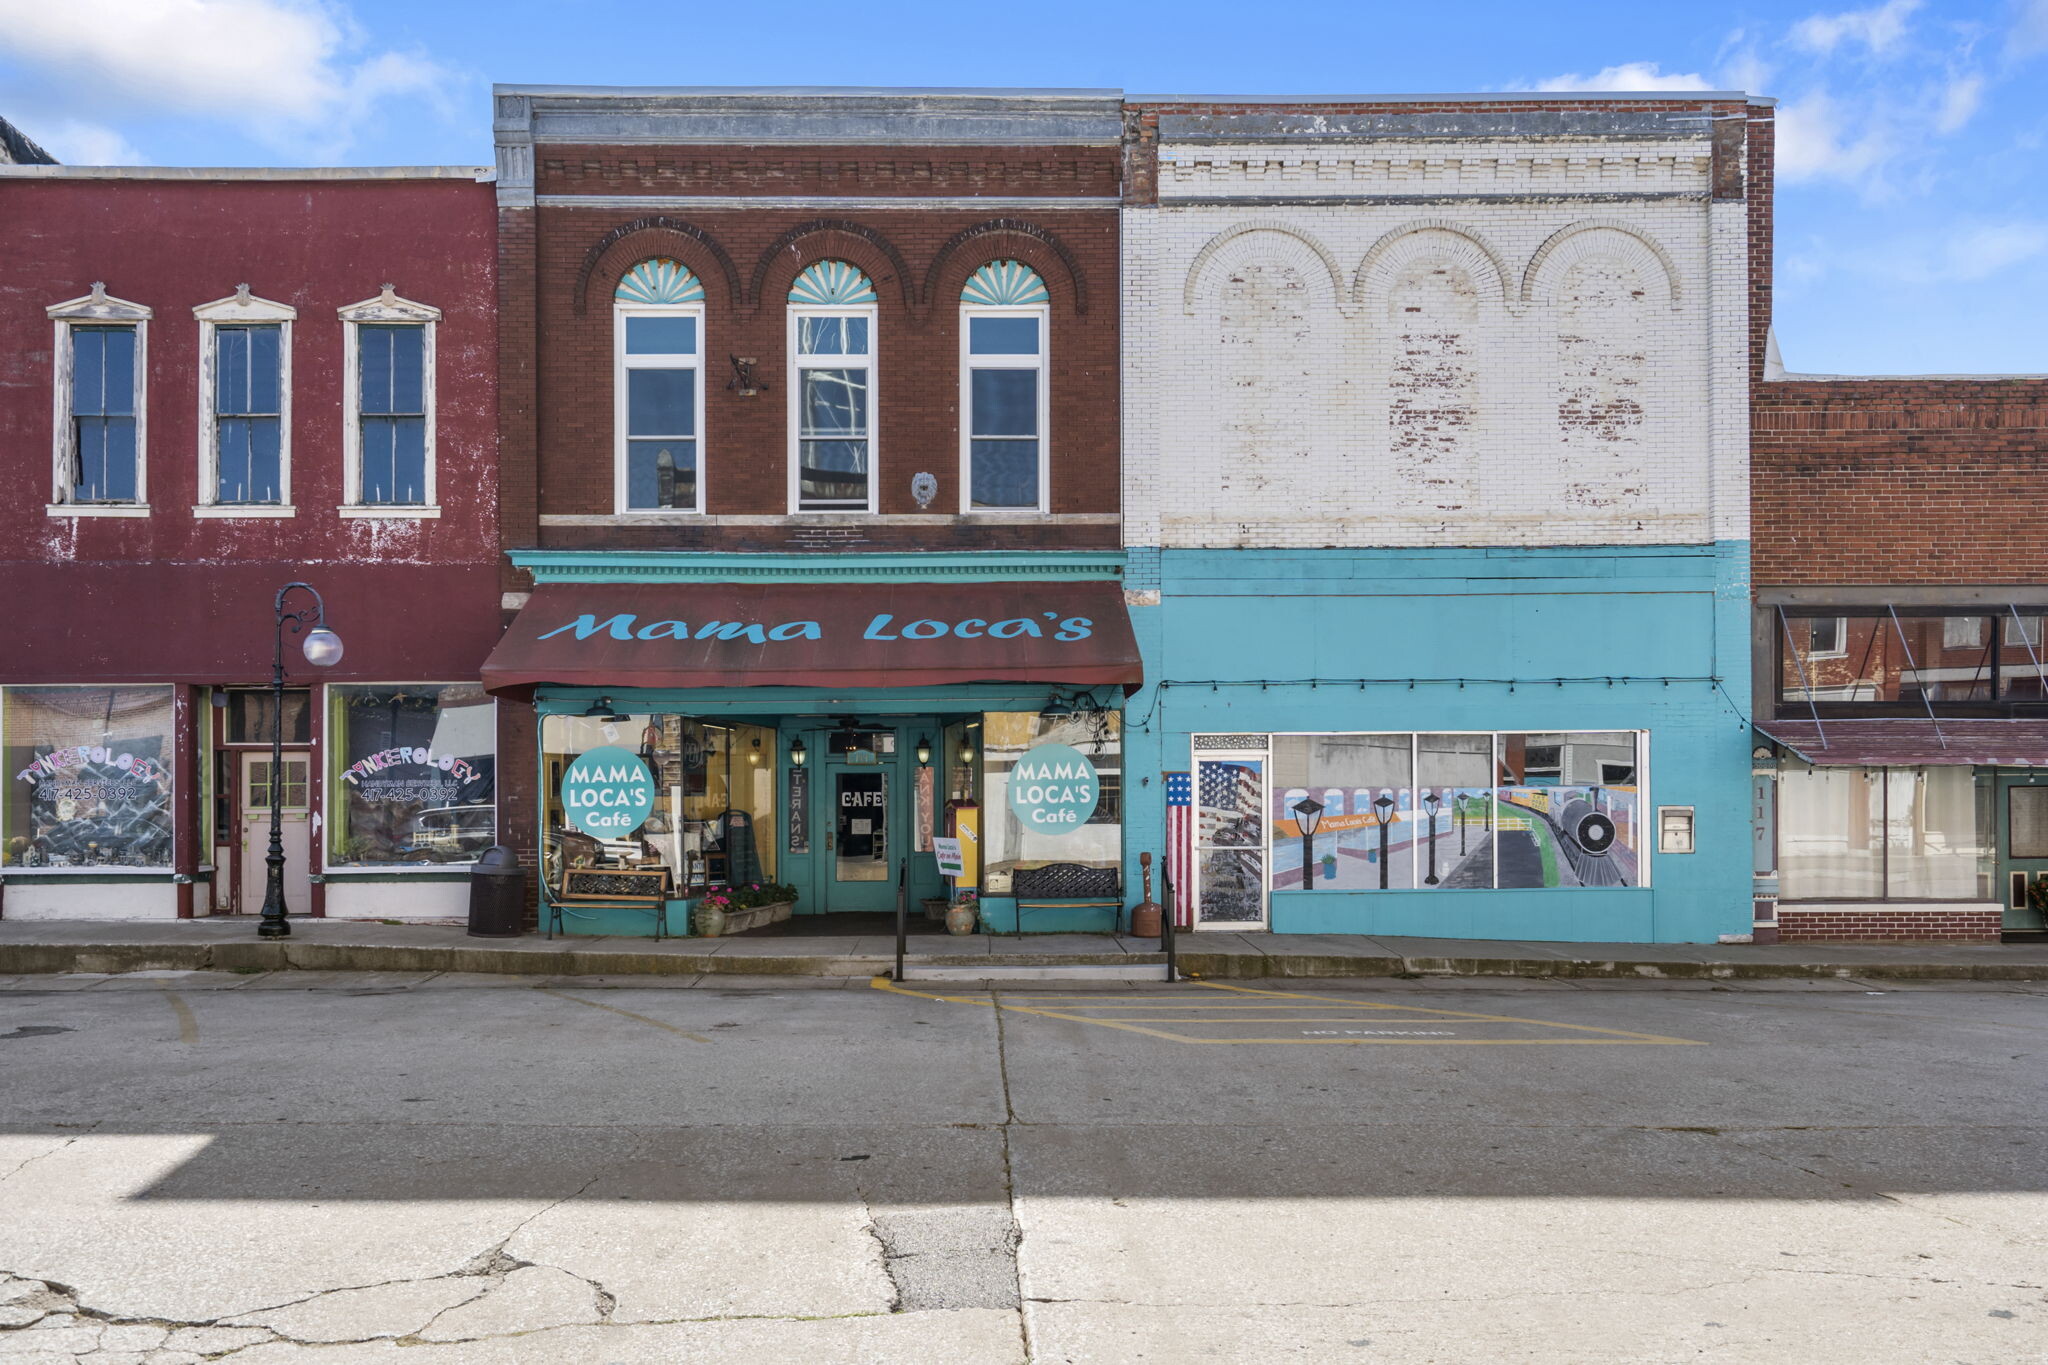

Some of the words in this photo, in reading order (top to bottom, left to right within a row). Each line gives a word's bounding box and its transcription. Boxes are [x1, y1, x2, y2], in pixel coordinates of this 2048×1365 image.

[537, 613, 822, 644] Mama
[863, 611, 1093, 641] Loca's
[16, 745, 161, 784] TINKEROLOGY
[339, 746, 481, 785] TINKEROLOGY
[1016, 761, 1091, 781] MAMA
[570, 765, 646, 784] MAMA
[38, 786, 137, 801] 417-425-0392
[360, 787, 458, 801] 417-425-0392
[569, 788, 647, 808] LOCA'S
[841, 791, 882, 807] CAFE
[1016, 784, 1091, 804] LOCA'S
[585, 811, 632, 827] Café
[1031, 807, 1077, 824] Café
